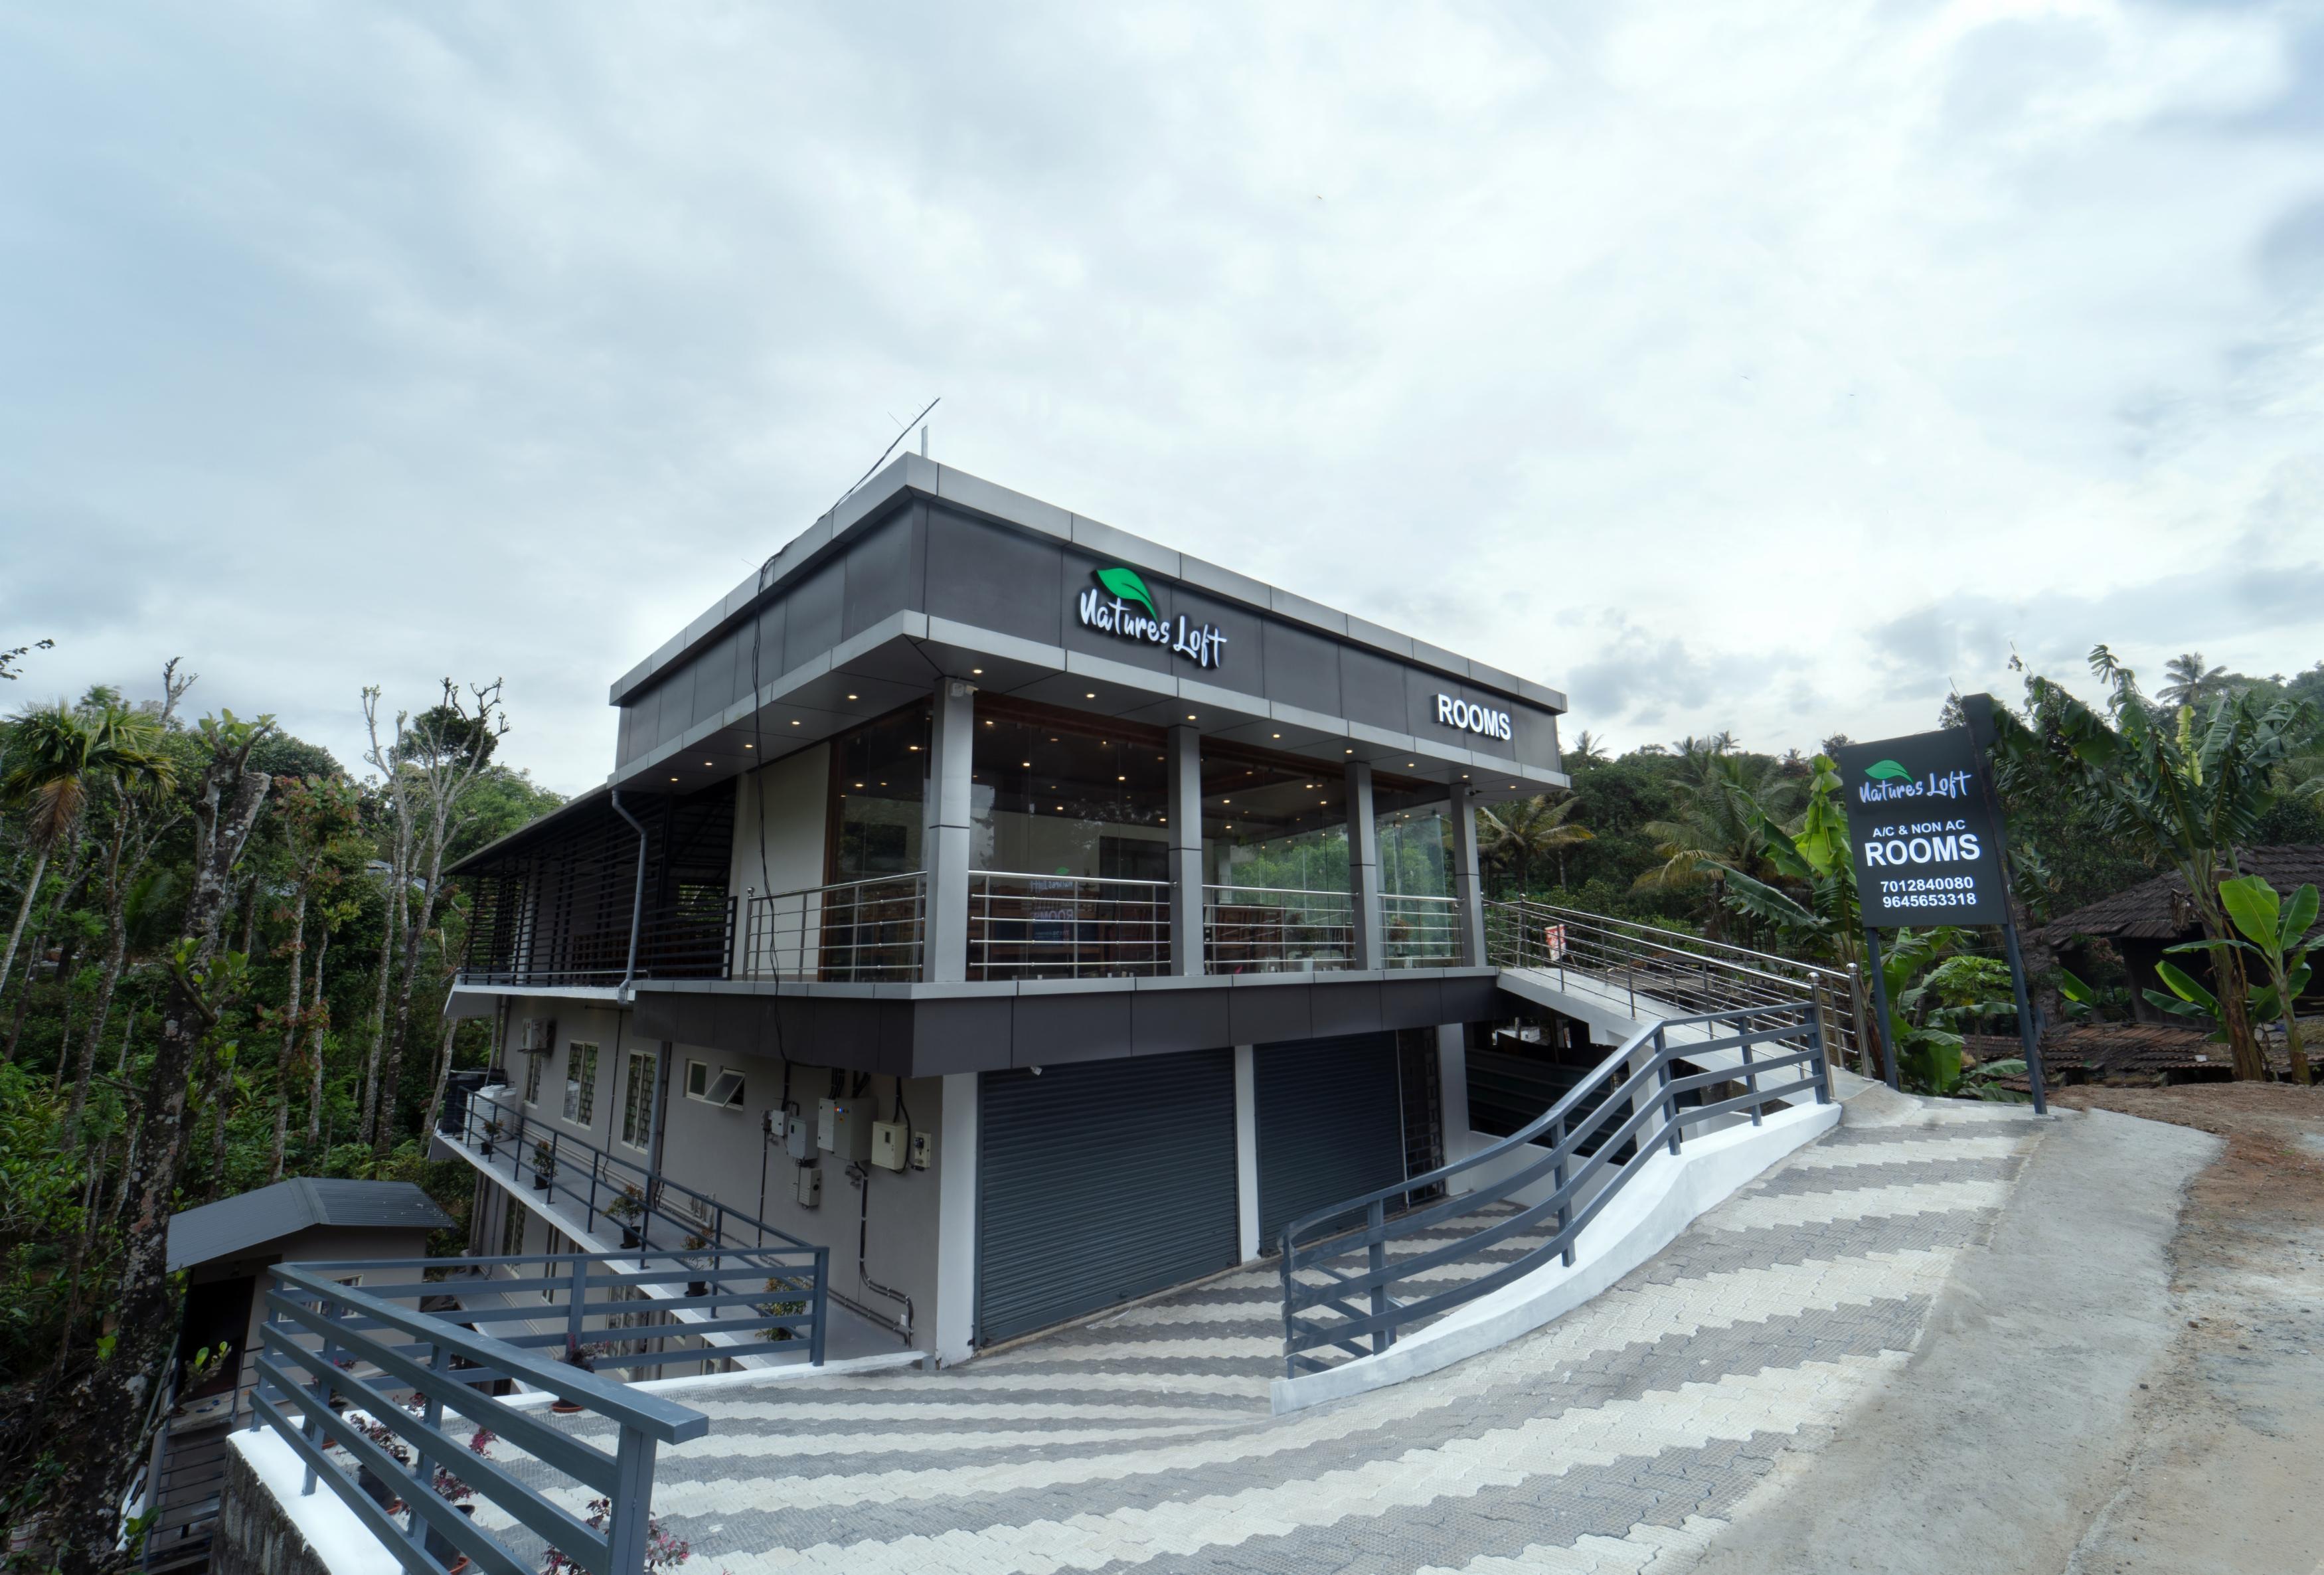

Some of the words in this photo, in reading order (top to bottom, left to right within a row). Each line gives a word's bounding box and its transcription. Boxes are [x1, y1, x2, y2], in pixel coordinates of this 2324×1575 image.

[1080, 588, 1170, 644] Natures
[1173, 615, 1228, 669] Loft
[1437, 693, 1512, 741] ROOMS
[1859, 780, 1923, 803] Natures
[1926, 770, 1973, 799] Loft
[1872, 826, 1894, 838] A/C
[1898, 825, 1908, 836] &
[1911, 822, 1942, 835] NON
[1945, 819, 1966, 831] AC
[1865, 834, 1981, 867] ROOMS
[1880, 876, 1974, 892] 7012840080
[1882, 893, 1977, 908] 9645653318
